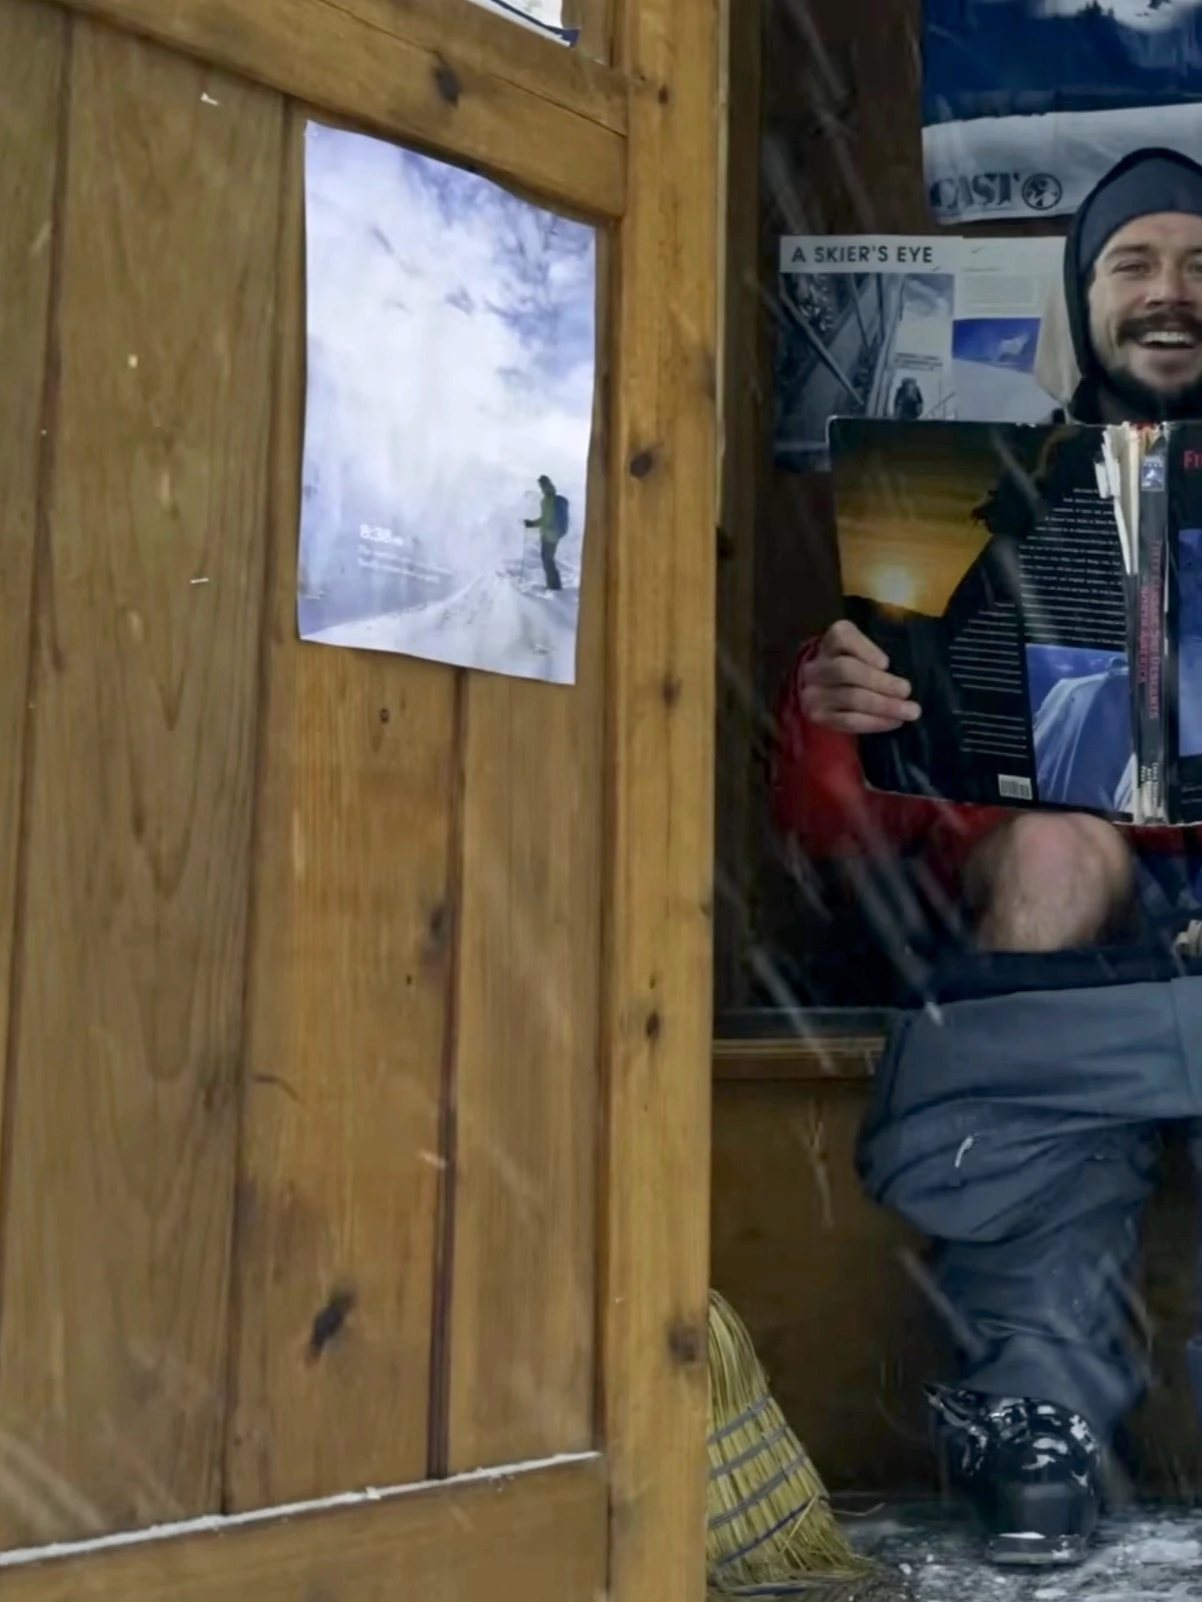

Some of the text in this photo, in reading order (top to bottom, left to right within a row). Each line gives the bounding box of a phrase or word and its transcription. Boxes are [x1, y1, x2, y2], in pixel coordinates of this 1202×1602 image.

[792, 245, 932, 263] A SKIER'S EYE
